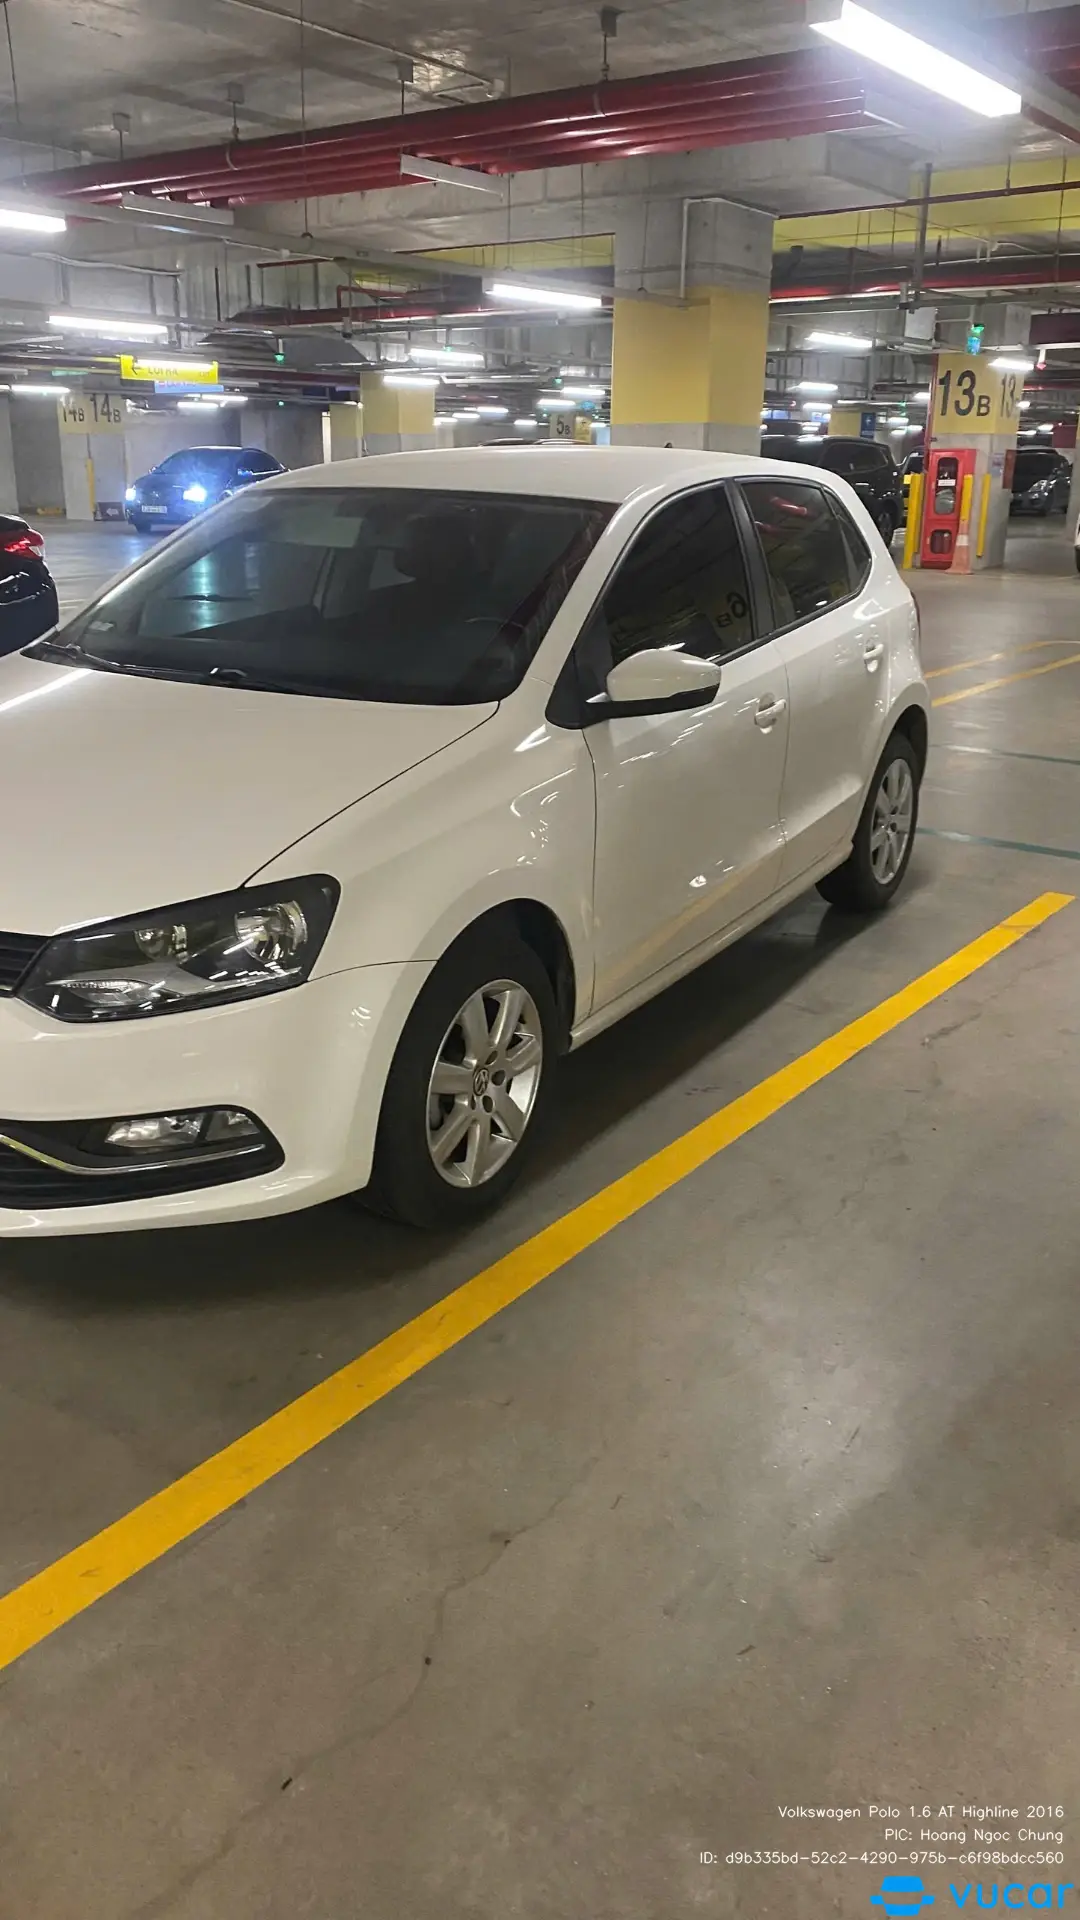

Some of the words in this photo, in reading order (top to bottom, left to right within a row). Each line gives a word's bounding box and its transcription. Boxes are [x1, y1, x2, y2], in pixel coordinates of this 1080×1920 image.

[90, 393, 121, 423] 14B
[938, 370, 991, 416] 13B
[1000, 372, 1020, 418] 13
